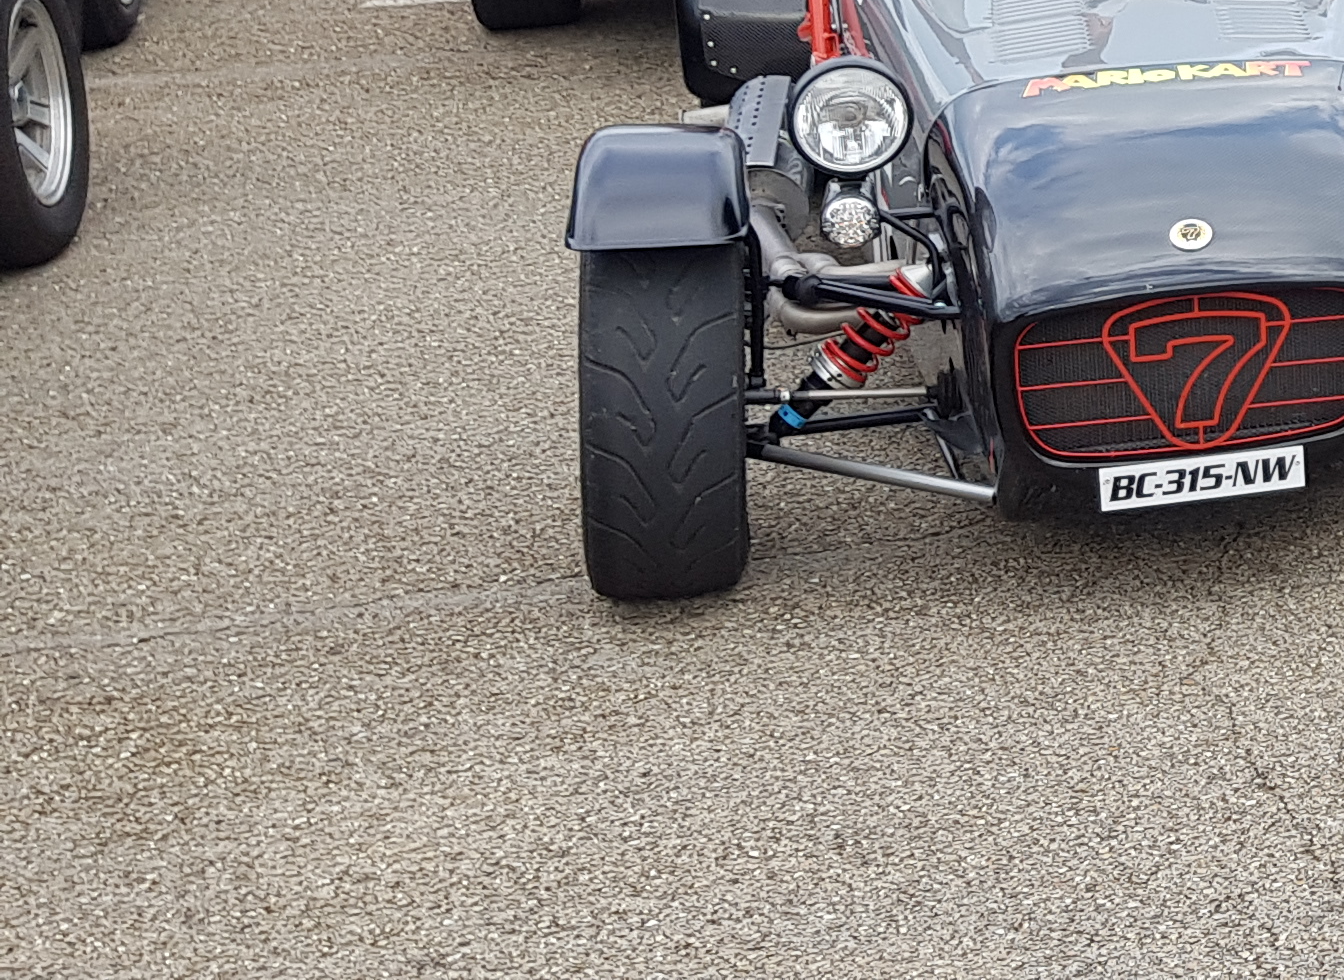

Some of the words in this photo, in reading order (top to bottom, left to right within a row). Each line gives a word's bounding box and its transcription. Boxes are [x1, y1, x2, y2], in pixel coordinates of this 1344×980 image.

[1021, 68, 1176, 98] MARIO
[1176, 61, 1310, 80] KART
[1130, 311, 1267, 429] 7
[1109, 454, 1297, 502] BC-315-NW
